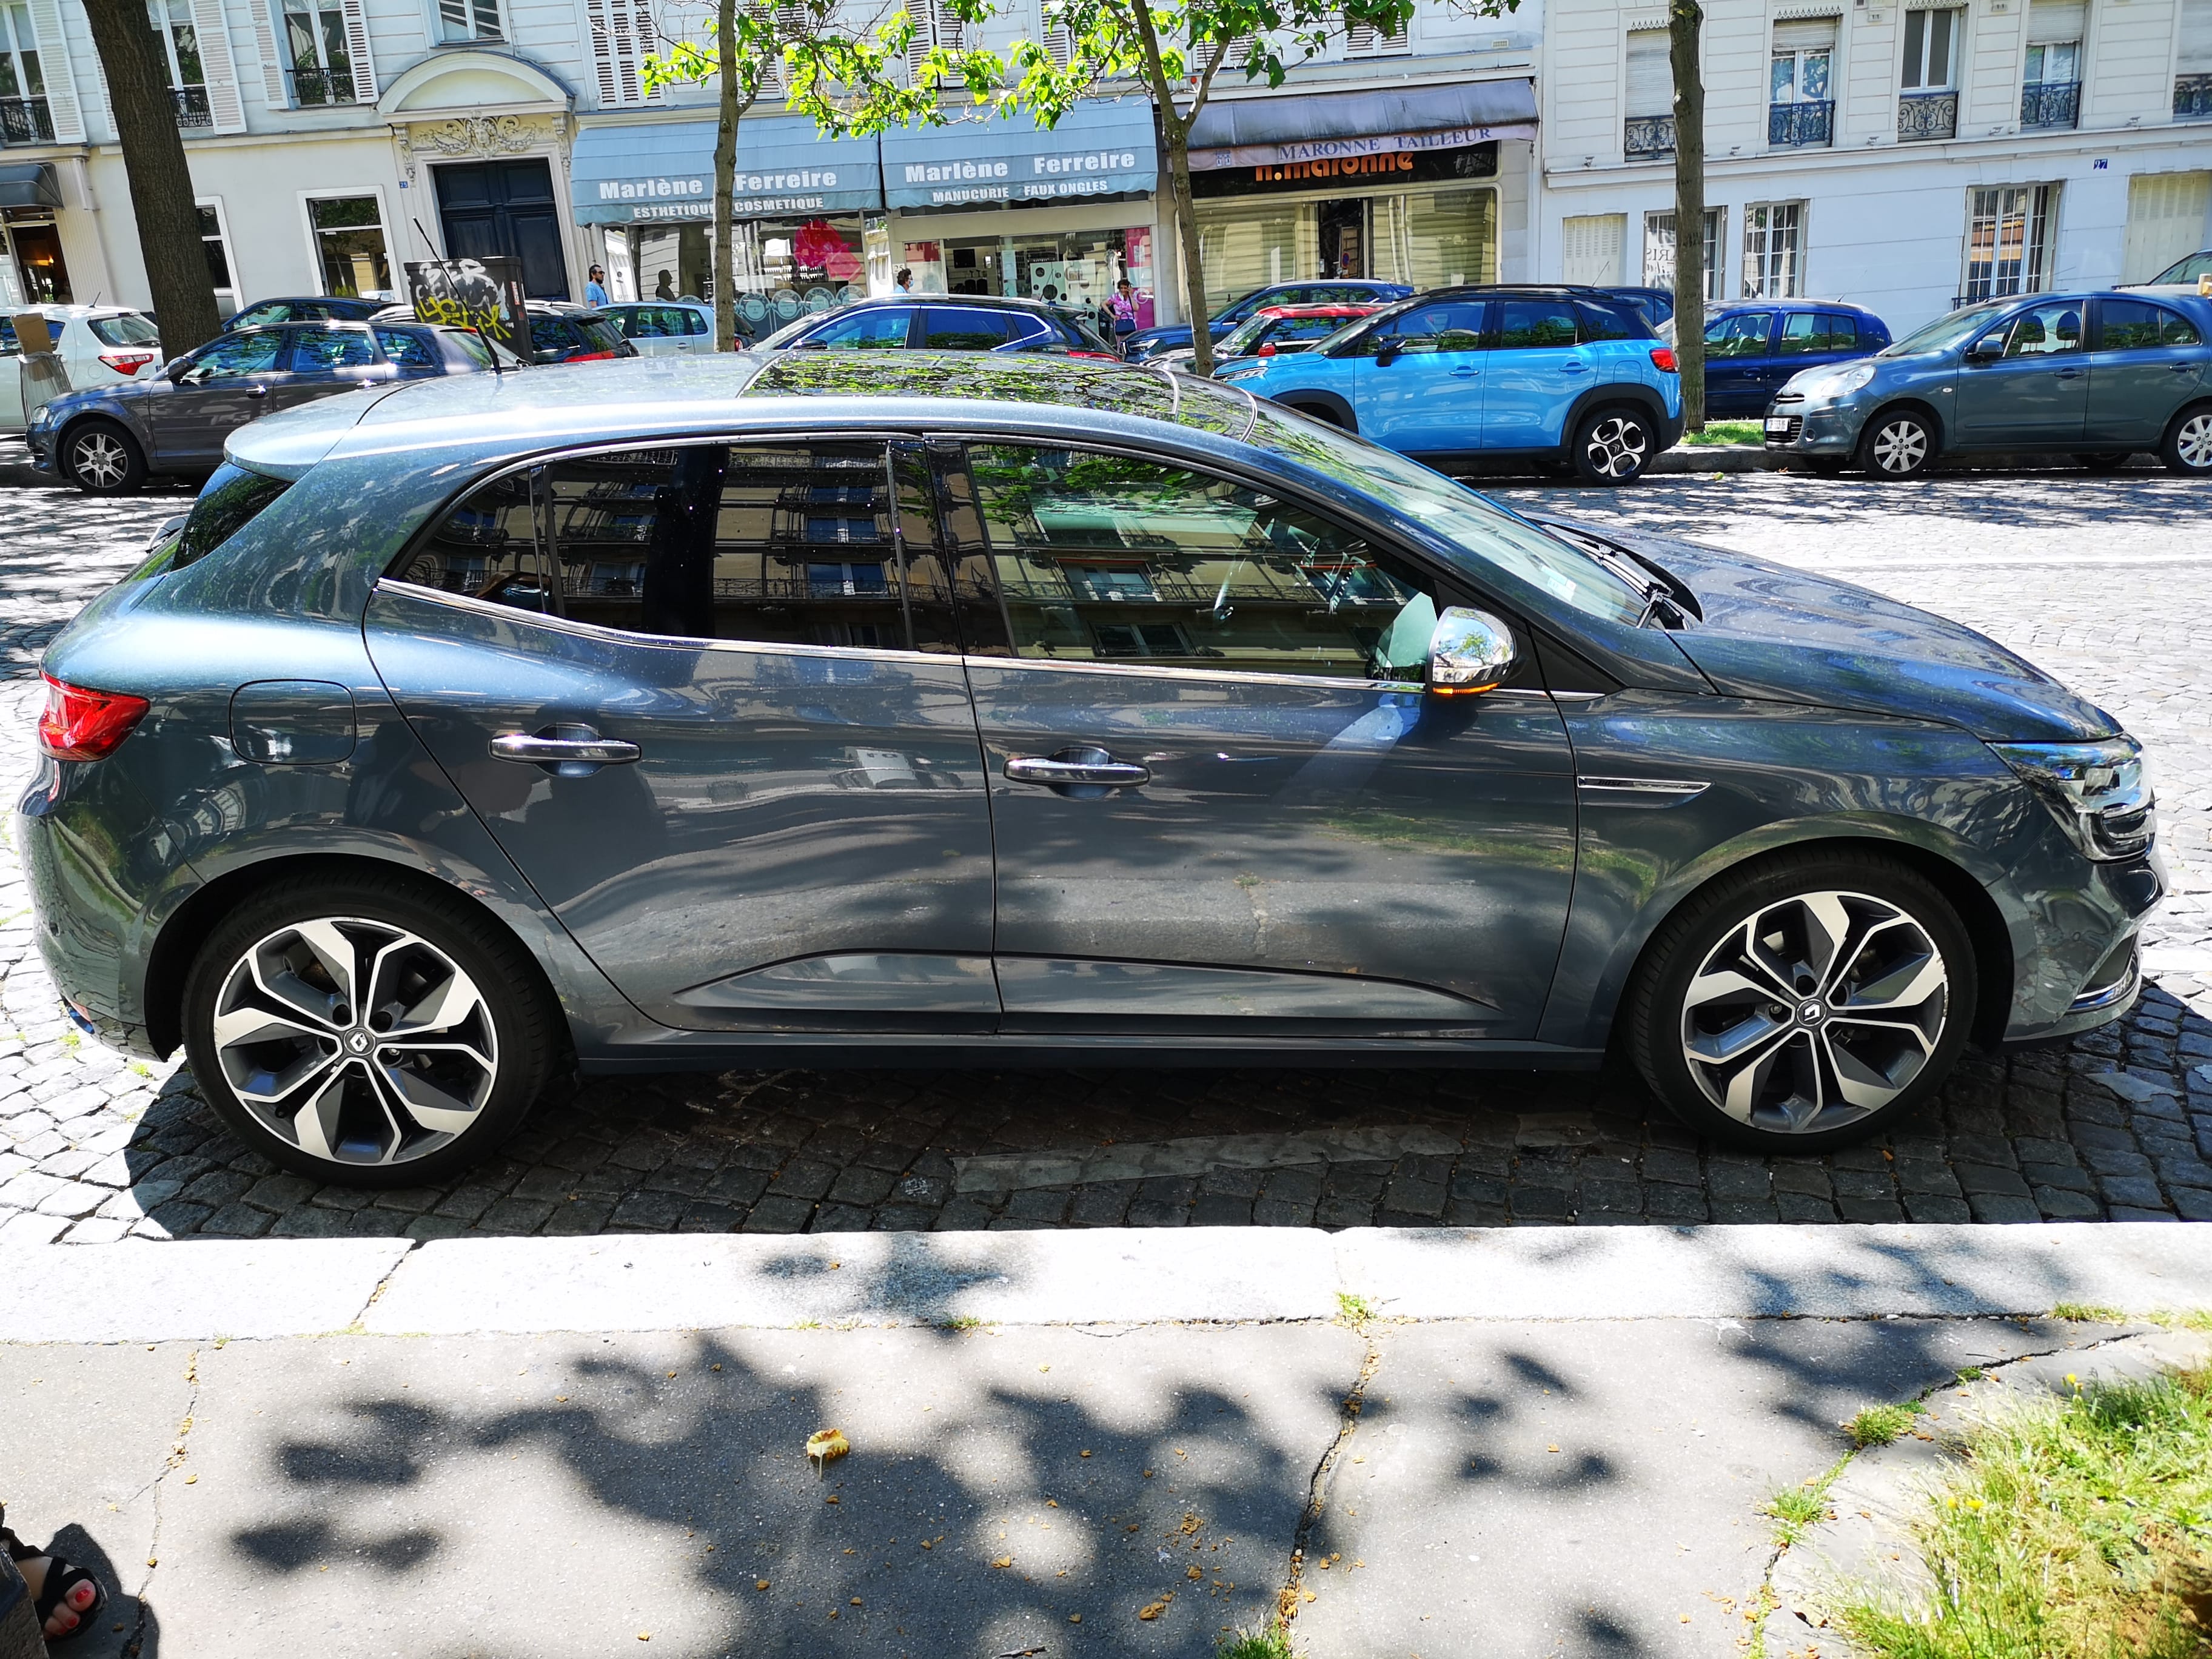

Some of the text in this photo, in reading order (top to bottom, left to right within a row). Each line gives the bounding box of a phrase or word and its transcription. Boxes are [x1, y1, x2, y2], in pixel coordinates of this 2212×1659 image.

[1279, 128, 1491, 160] MARONNE TAILLEUR
[905, 152, 1135, 183] Marlène Ferreire
[1256, 152, 1413, 181] n.maronne
[2094, 159, 2107, 170] 27
[599, 171, 837, 199] Marlène Ferreire
[933, 180, 1107, 203] MANUCURIE FAUX ONGLES
[734, 198, 823, 212] COSMETIQUE
